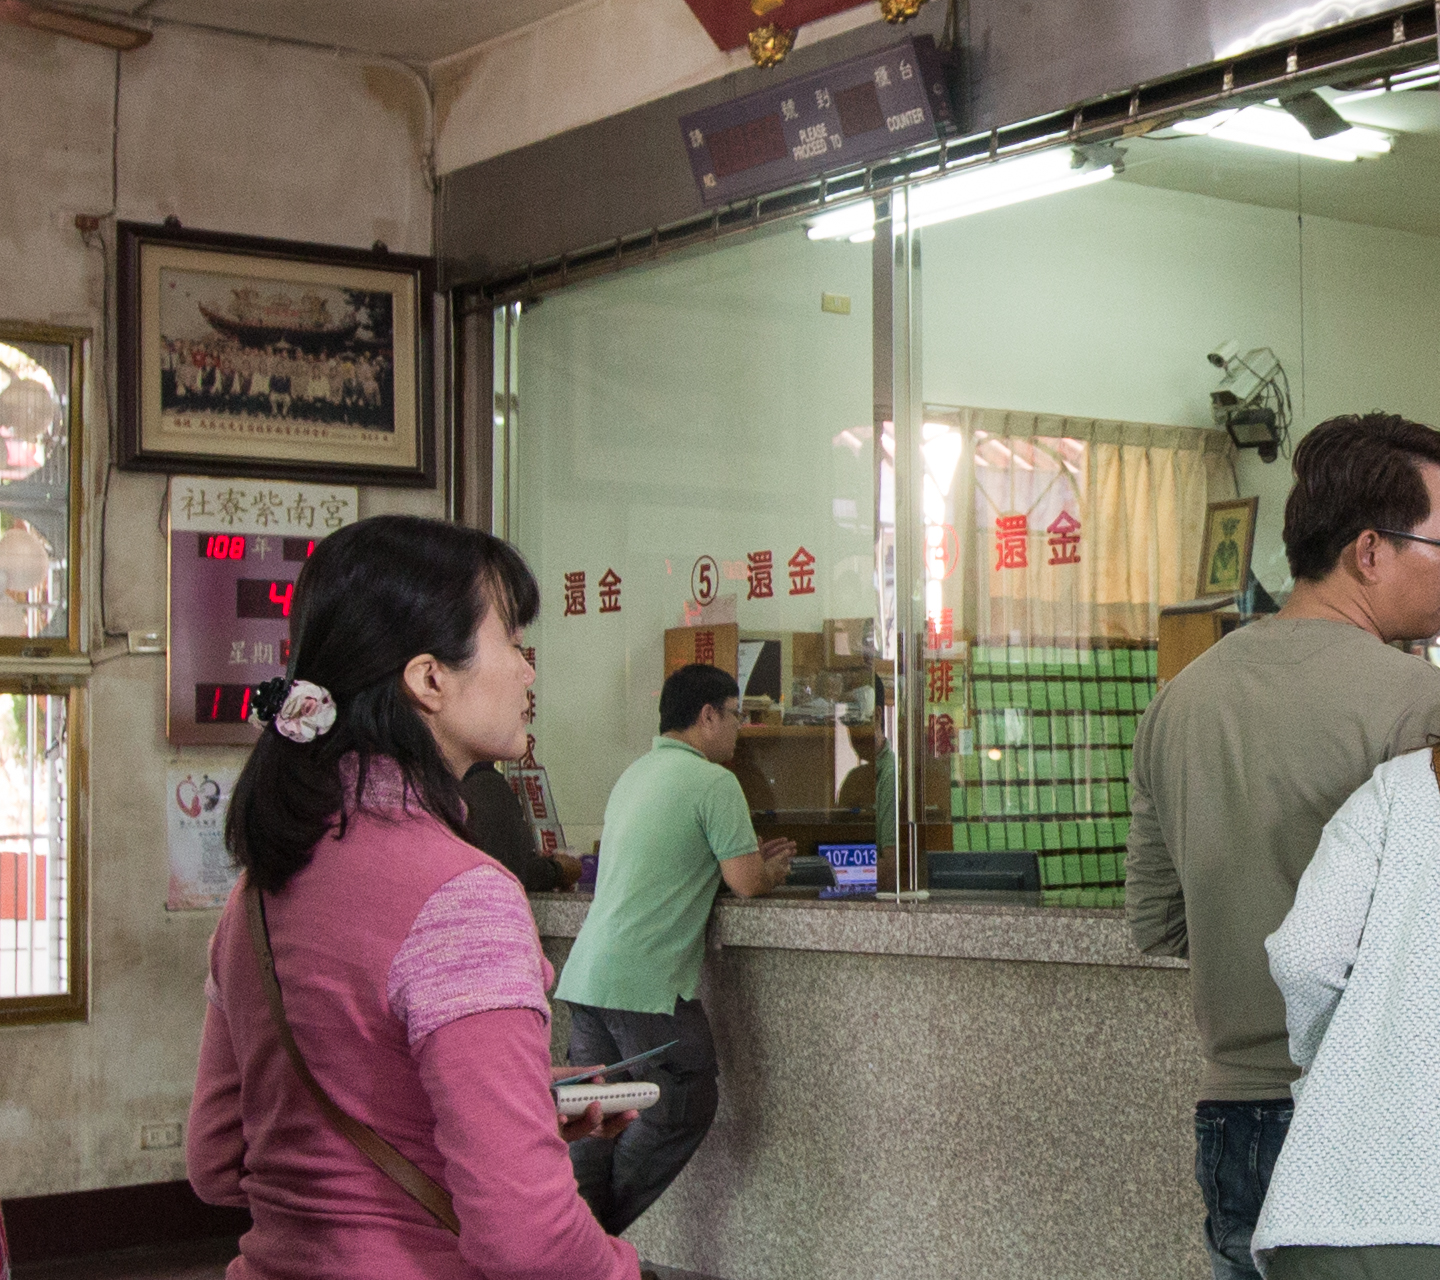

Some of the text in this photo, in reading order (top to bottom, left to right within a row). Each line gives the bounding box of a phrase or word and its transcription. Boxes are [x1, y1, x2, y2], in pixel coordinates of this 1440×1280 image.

[799, 123, 827, 144] PLEASE
[887, 108, 925, 133] COUNTER
[793, 135, 842, 161] PROCEED TO
[180, 487, 348, 528] 社寮紫南宮
[207, 535, 245, 560] 108
[252, 536, 272, 559] 年
[995, 510, 1081, 571] 還金
[746, 546, 815, 601] 還金
[269, 582, 294, 617] 4
[564, 567, 622, 617] 還金
[229, 641, 273, 665] 星期
[927, 607, 955, 756] 請排隊
